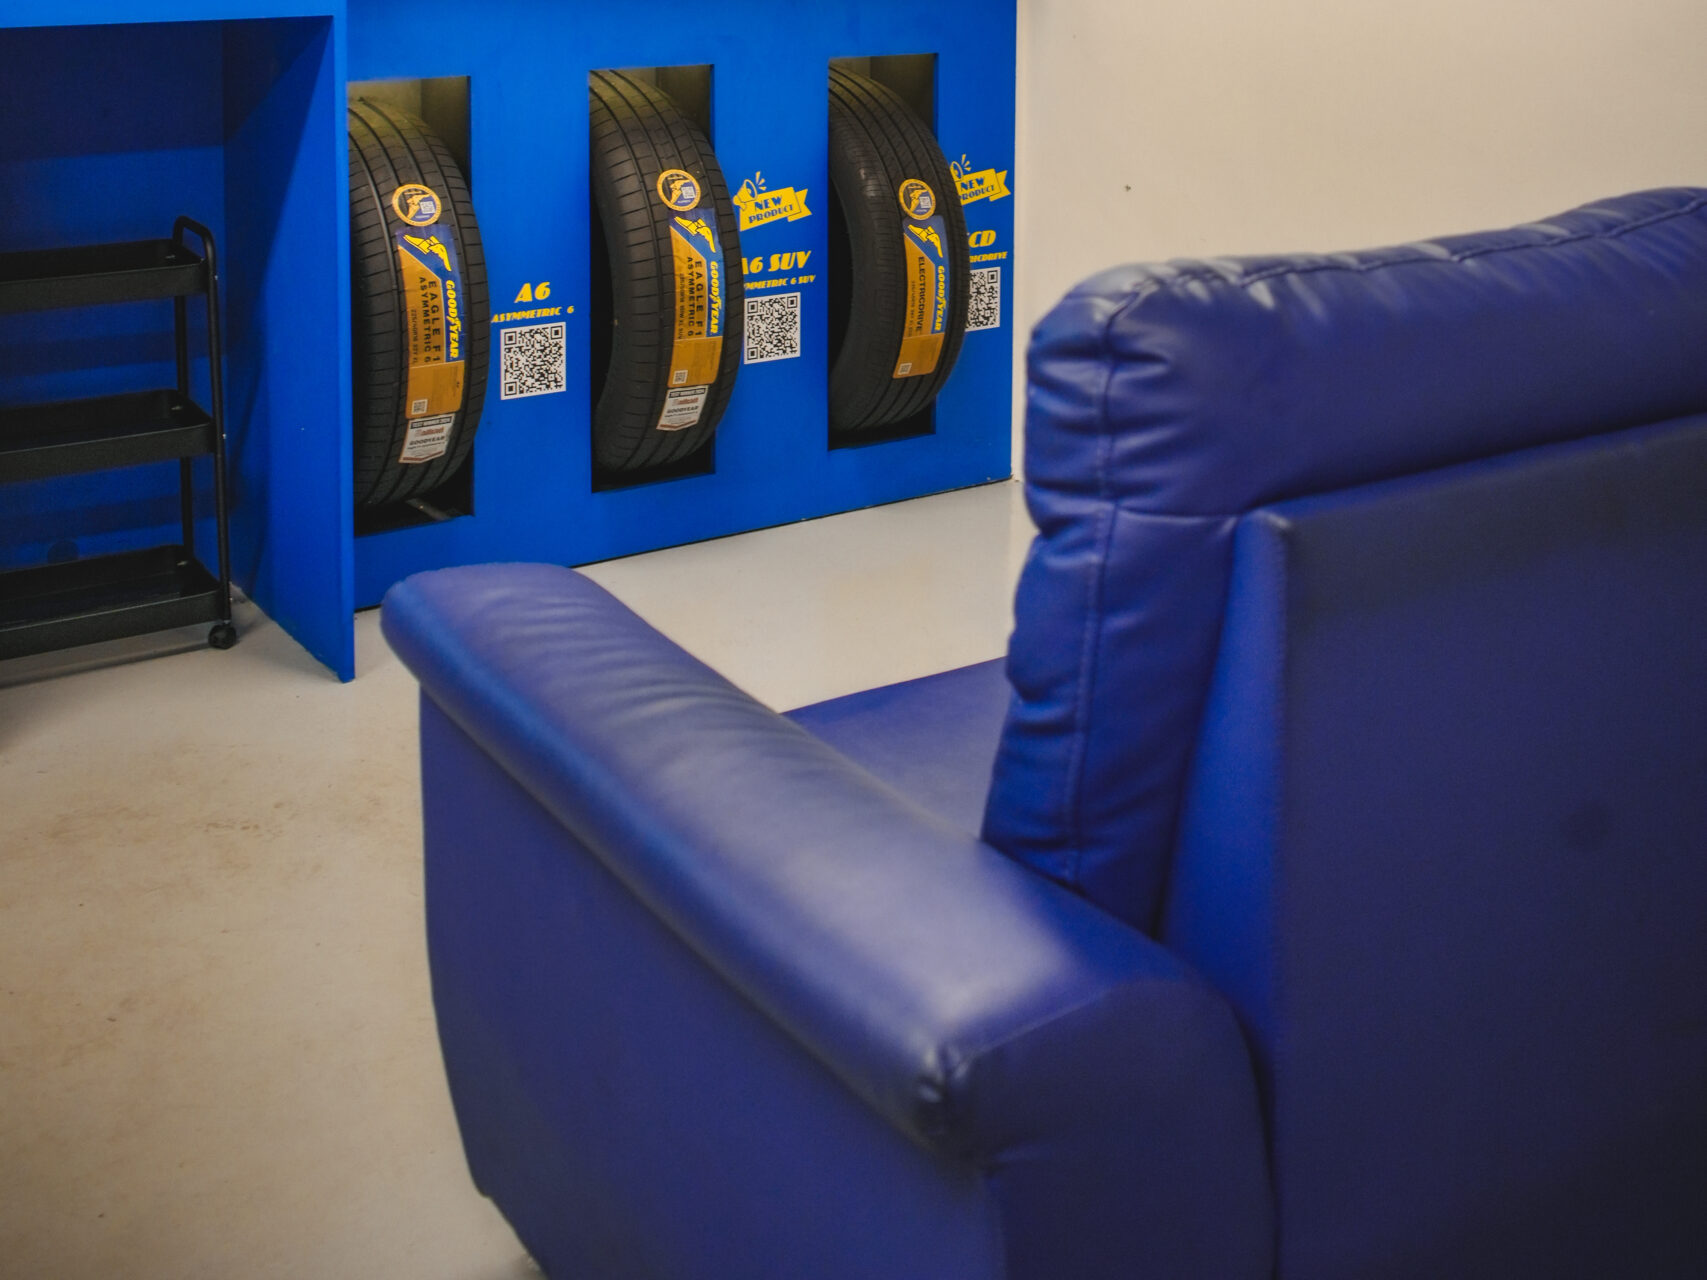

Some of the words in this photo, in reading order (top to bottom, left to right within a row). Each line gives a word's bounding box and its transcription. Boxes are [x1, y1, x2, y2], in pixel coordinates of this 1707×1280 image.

[960, 177, 985, 191] NEW
[961, 184, 995, 200] RODUCT
[754, 195, 782, 212] NEW
[748, 204, 794, 224] PRODUCT
[967, 229, 996, 248] CD
[768, 250, 812, 272] SUV
[695, 261, 704, 312] EAGLE
[790, 277, 797, 285] 6
[798, 274, 816, 285] SUV
[514, 281, 551, 303] A6
[687, 256, 696, 327] ASYMMETRIC
[915, 256, 926, 332] ELECTRICDRIVE
[419, 276, 432, 353] ASYMMETRIC
[428, 280, 441, 336] EAGLE
[490, 306, 562, 323] ASYMMETRIC
[566, 305, 575, 314] 6
[695, 320, 703, 336] F1
[431, 344, 441, 362] F1
